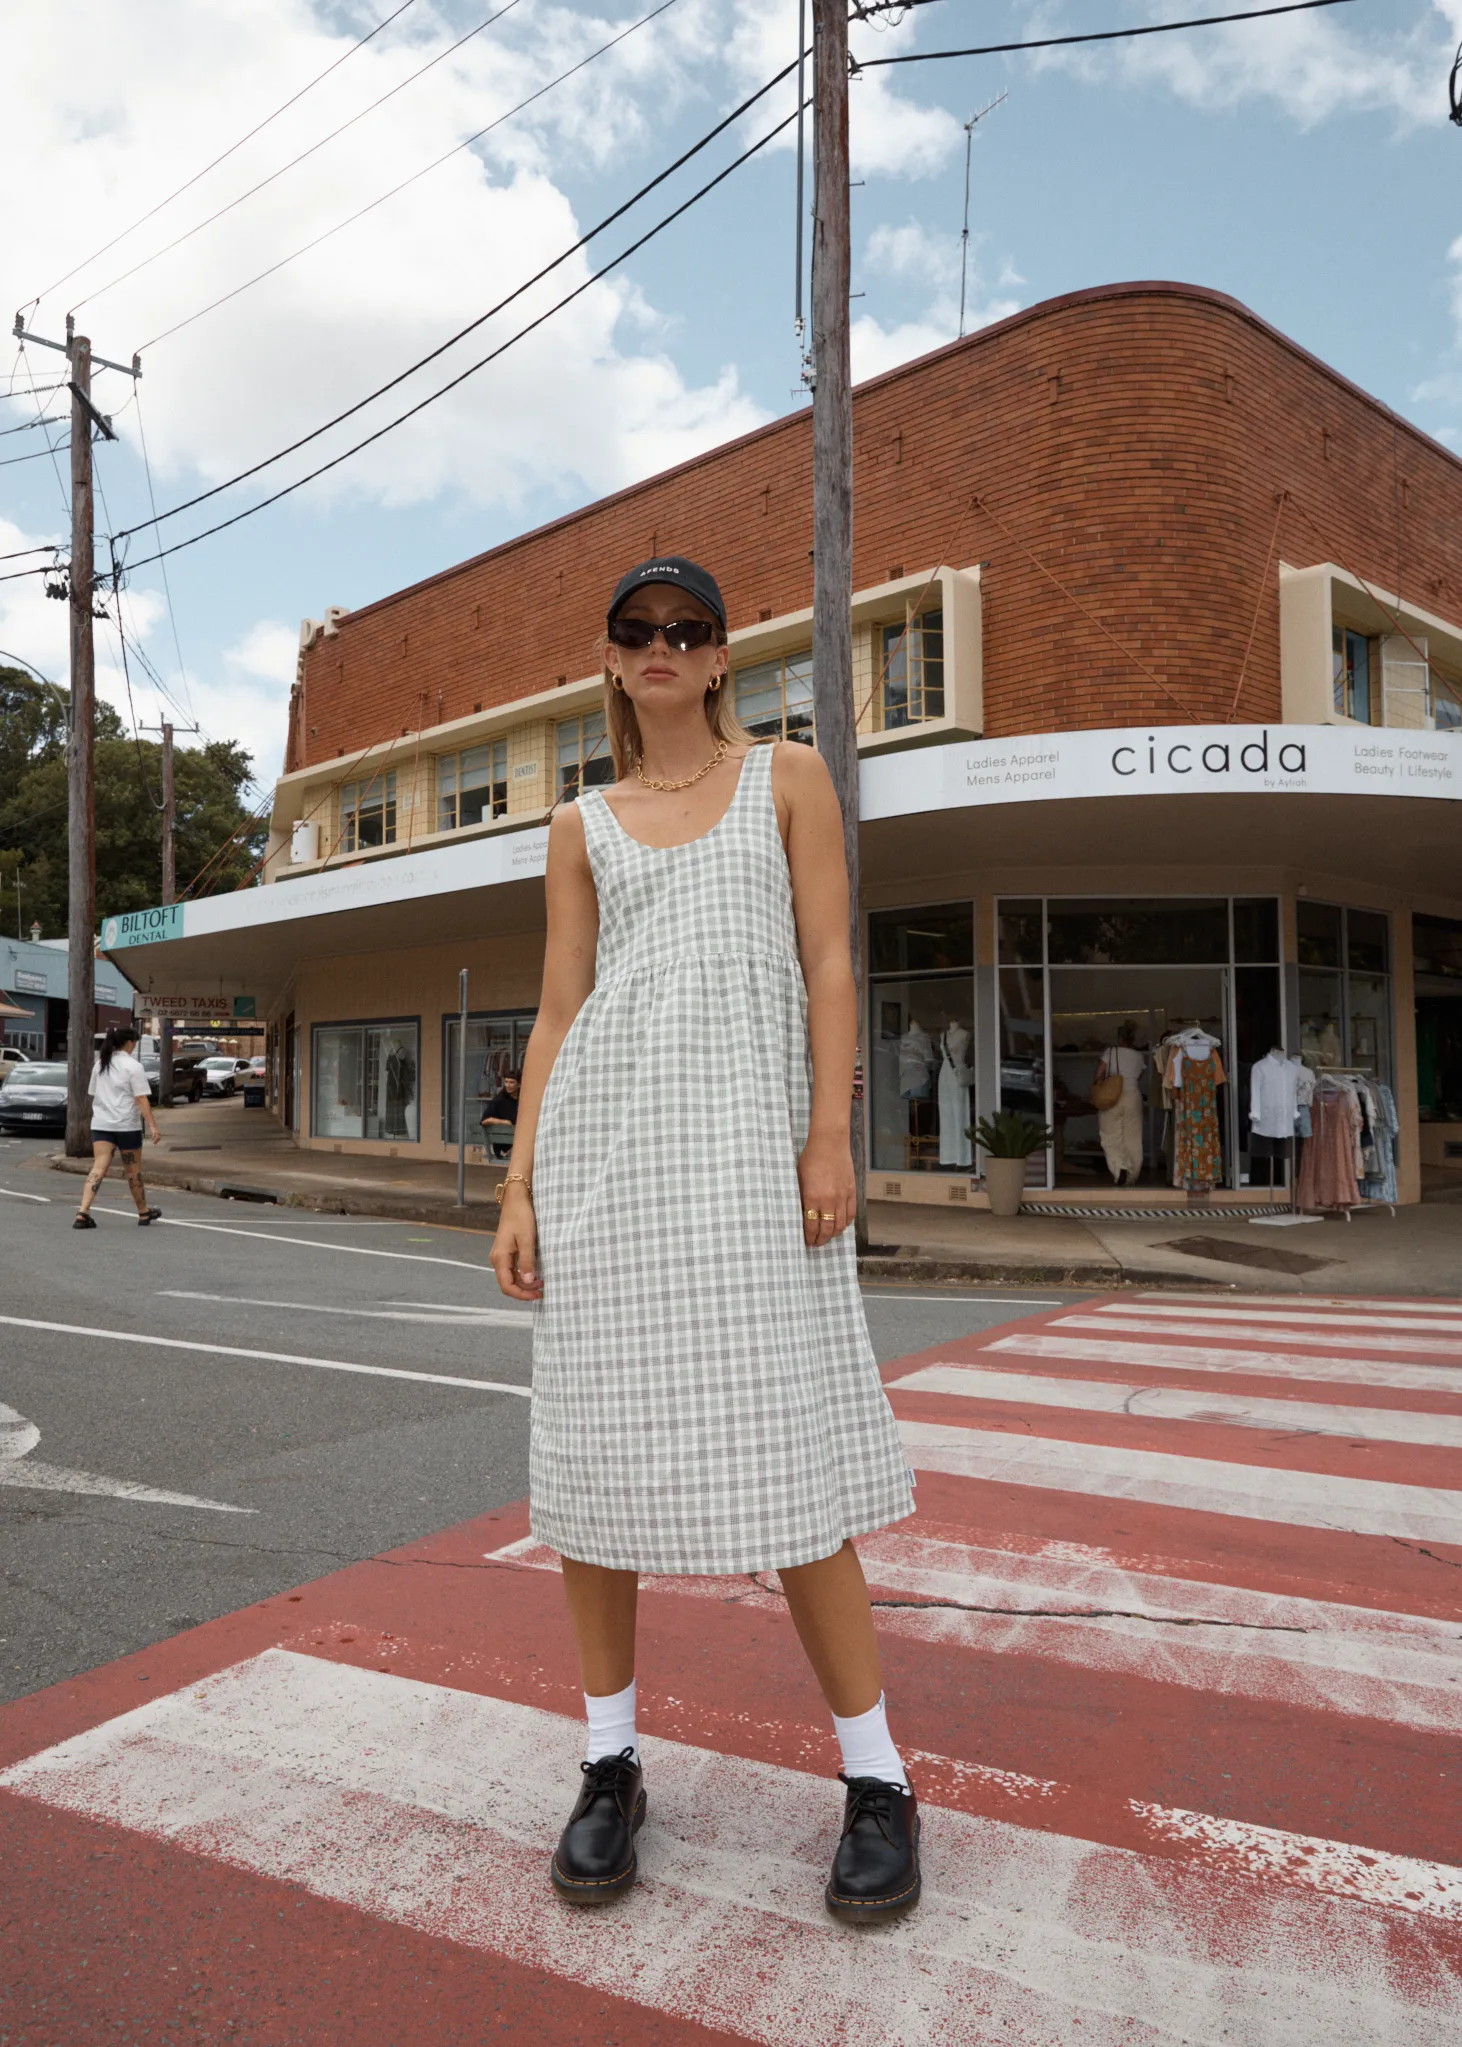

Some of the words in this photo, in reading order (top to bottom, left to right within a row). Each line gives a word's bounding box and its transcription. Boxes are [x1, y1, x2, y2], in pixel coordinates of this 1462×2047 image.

[966, 757, 1007, 770] Ladies
[1010, 750, 1060, 767] Apparel
[1112, 730, 1306, 776] cicada
[1354, 745, 1393, 758] Ladies
[1398, 747, 1449, 761] Footwear
[515, 764, 537, 778] DENTIST
[966, 775, 1001, 786] Mens
[1004, 768, 1056, 784] Apparel
[1354, 762, 1395, 778] Beauty
[1408, 764, 1453, 781] Lifestyle
[1263, 778, 1276, 788] by
[512, 844, 531, 854] Ladies
[512, 857, 528, 866] Mens
[121, 905, 180, 934] BILTOFT
[129, 930, 168, 945] DENTAL
[142, 996, 188, 1008] TWEED
[191, 997, 228, 1010] TAXIS
